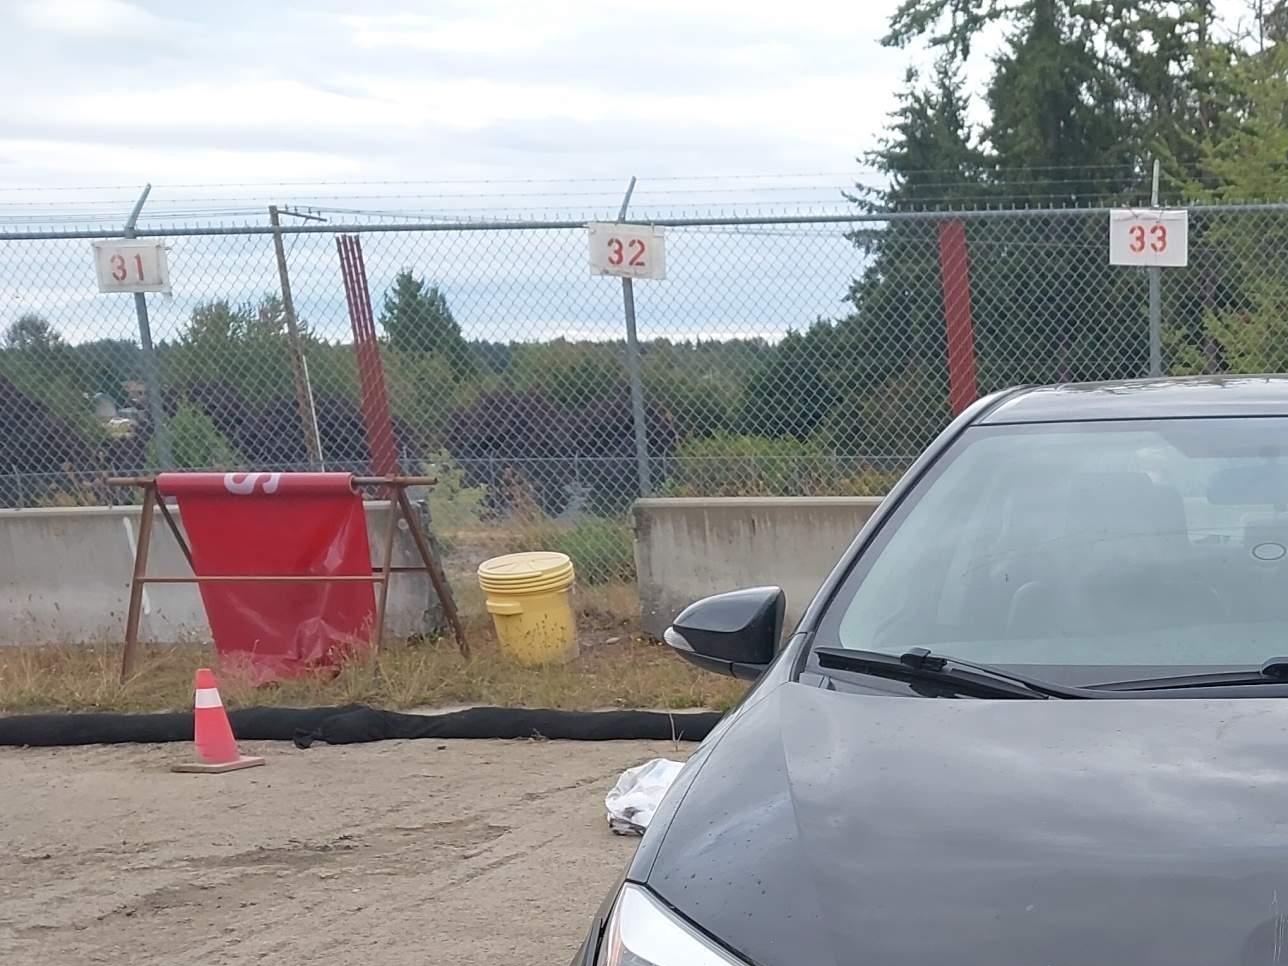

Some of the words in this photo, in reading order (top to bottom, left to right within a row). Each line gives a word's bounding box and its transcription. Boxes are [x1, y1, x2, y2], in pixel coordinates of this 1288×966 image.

[607, 238, 646, 267] 32
[1129, 225, 1167, 253] 33
[110, 253, 144, 281] 31
